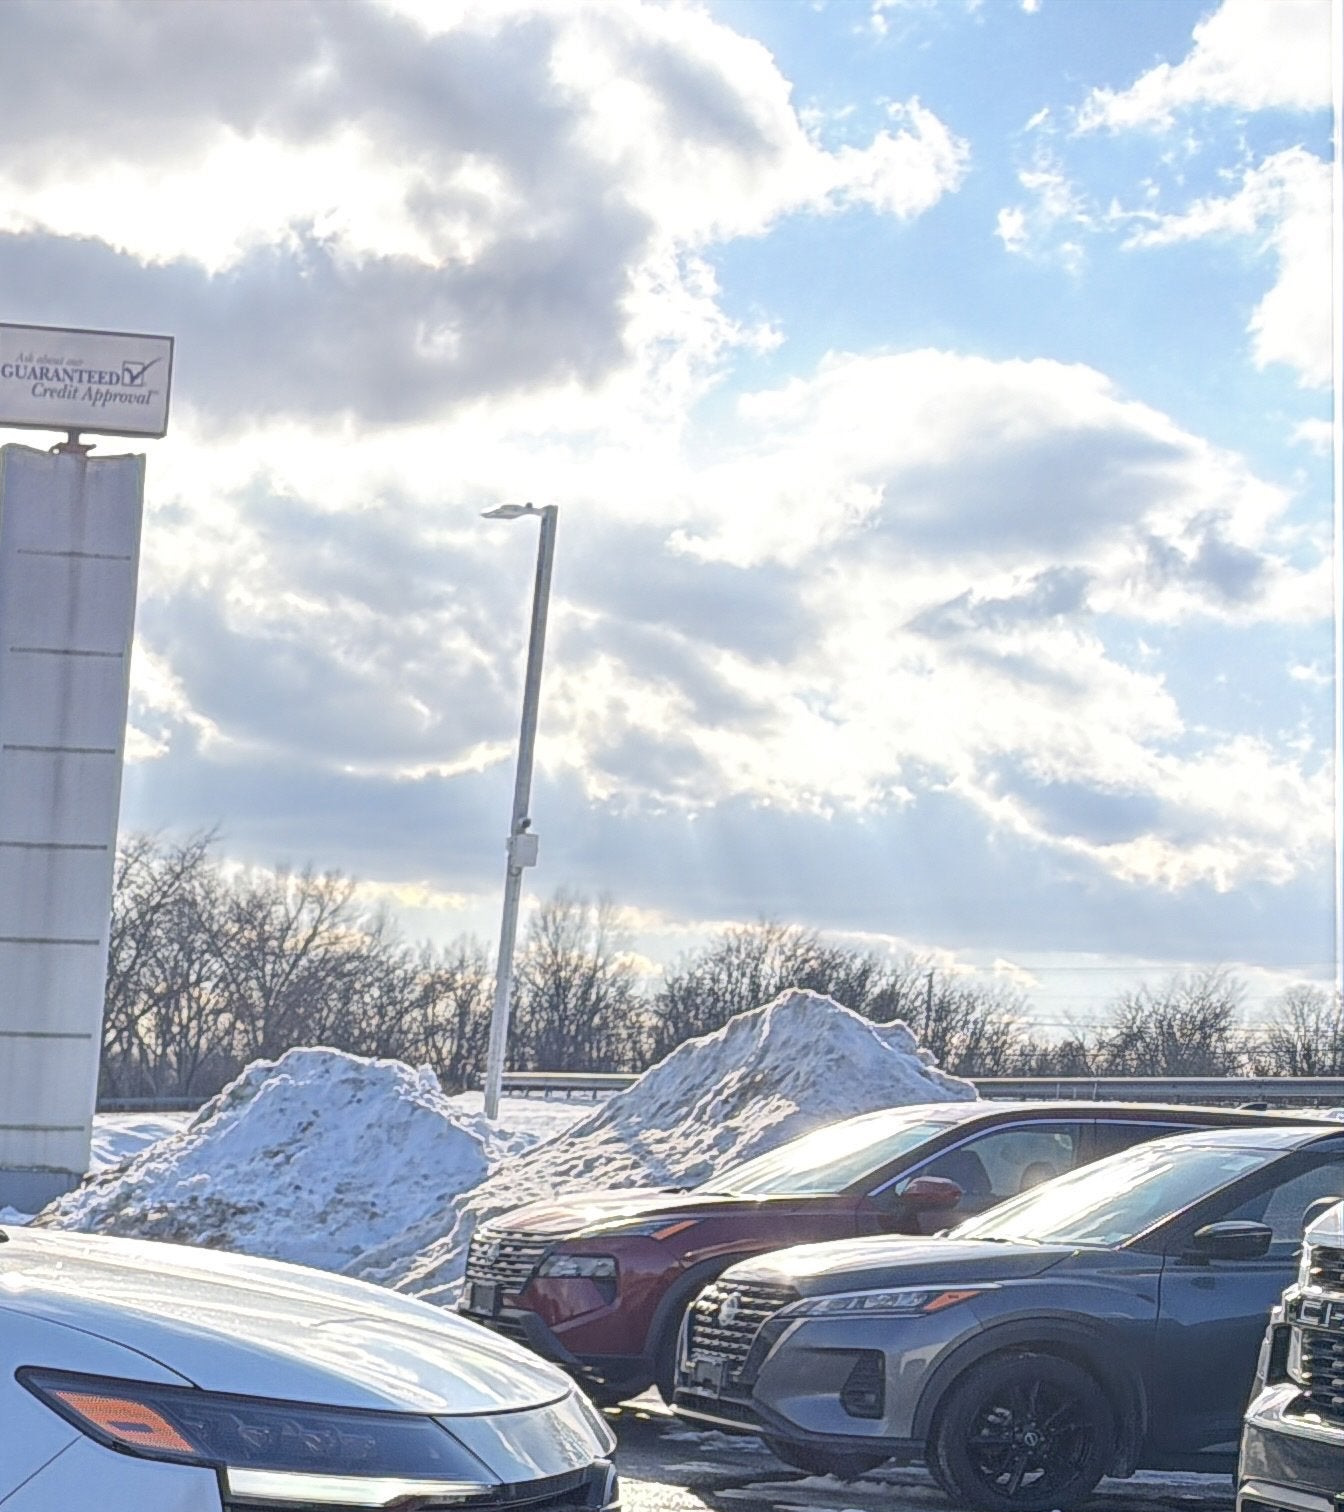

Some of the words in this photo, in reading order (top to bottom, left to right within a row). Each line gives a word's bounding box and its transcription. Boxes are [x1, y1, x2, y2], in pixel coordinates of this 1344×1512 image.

[0, 363, 121, 386] GUARANTEED
[31, 381, 78, 400] Credit
[81, 385, 152, 408] Approval
